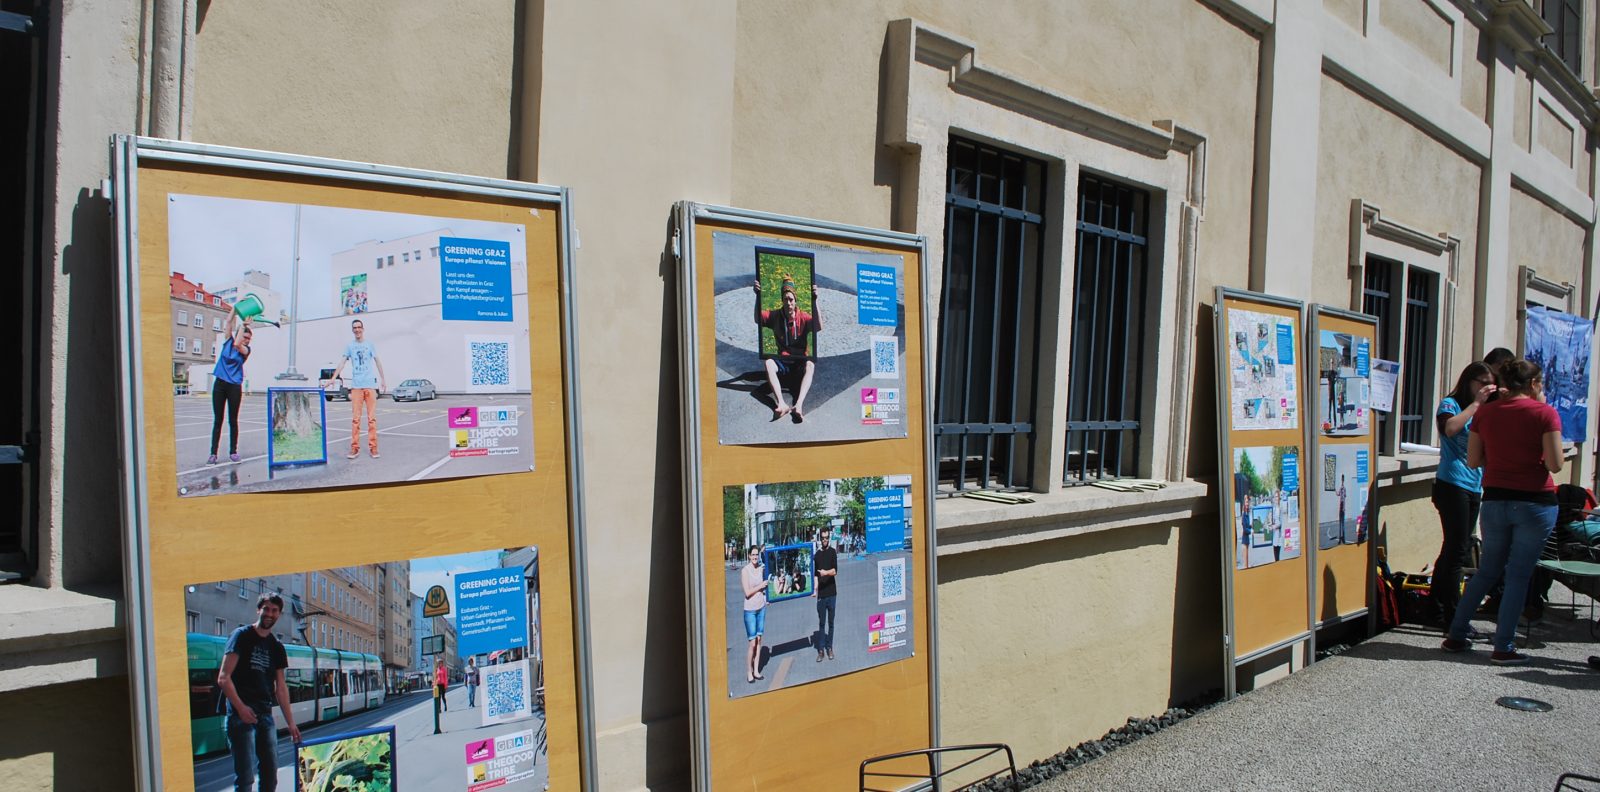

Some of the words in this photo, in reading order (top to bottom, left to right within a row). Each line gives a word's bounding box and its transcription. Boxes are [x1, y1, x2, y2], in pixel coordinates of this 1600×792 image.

[444, 246, 483, 256] GREENING
[484, 249, 506, 257] GRAZ
[480, 411, 517, 421] GRAZ
[469, 438, 498, 448] TRIBE
[460, 578, 497, 590] GREENING
[499, 575, 520, 584] GRAZ
[497, 735, 532, 751] GRAZ
[488, 765, 516, 779] TRIBE
